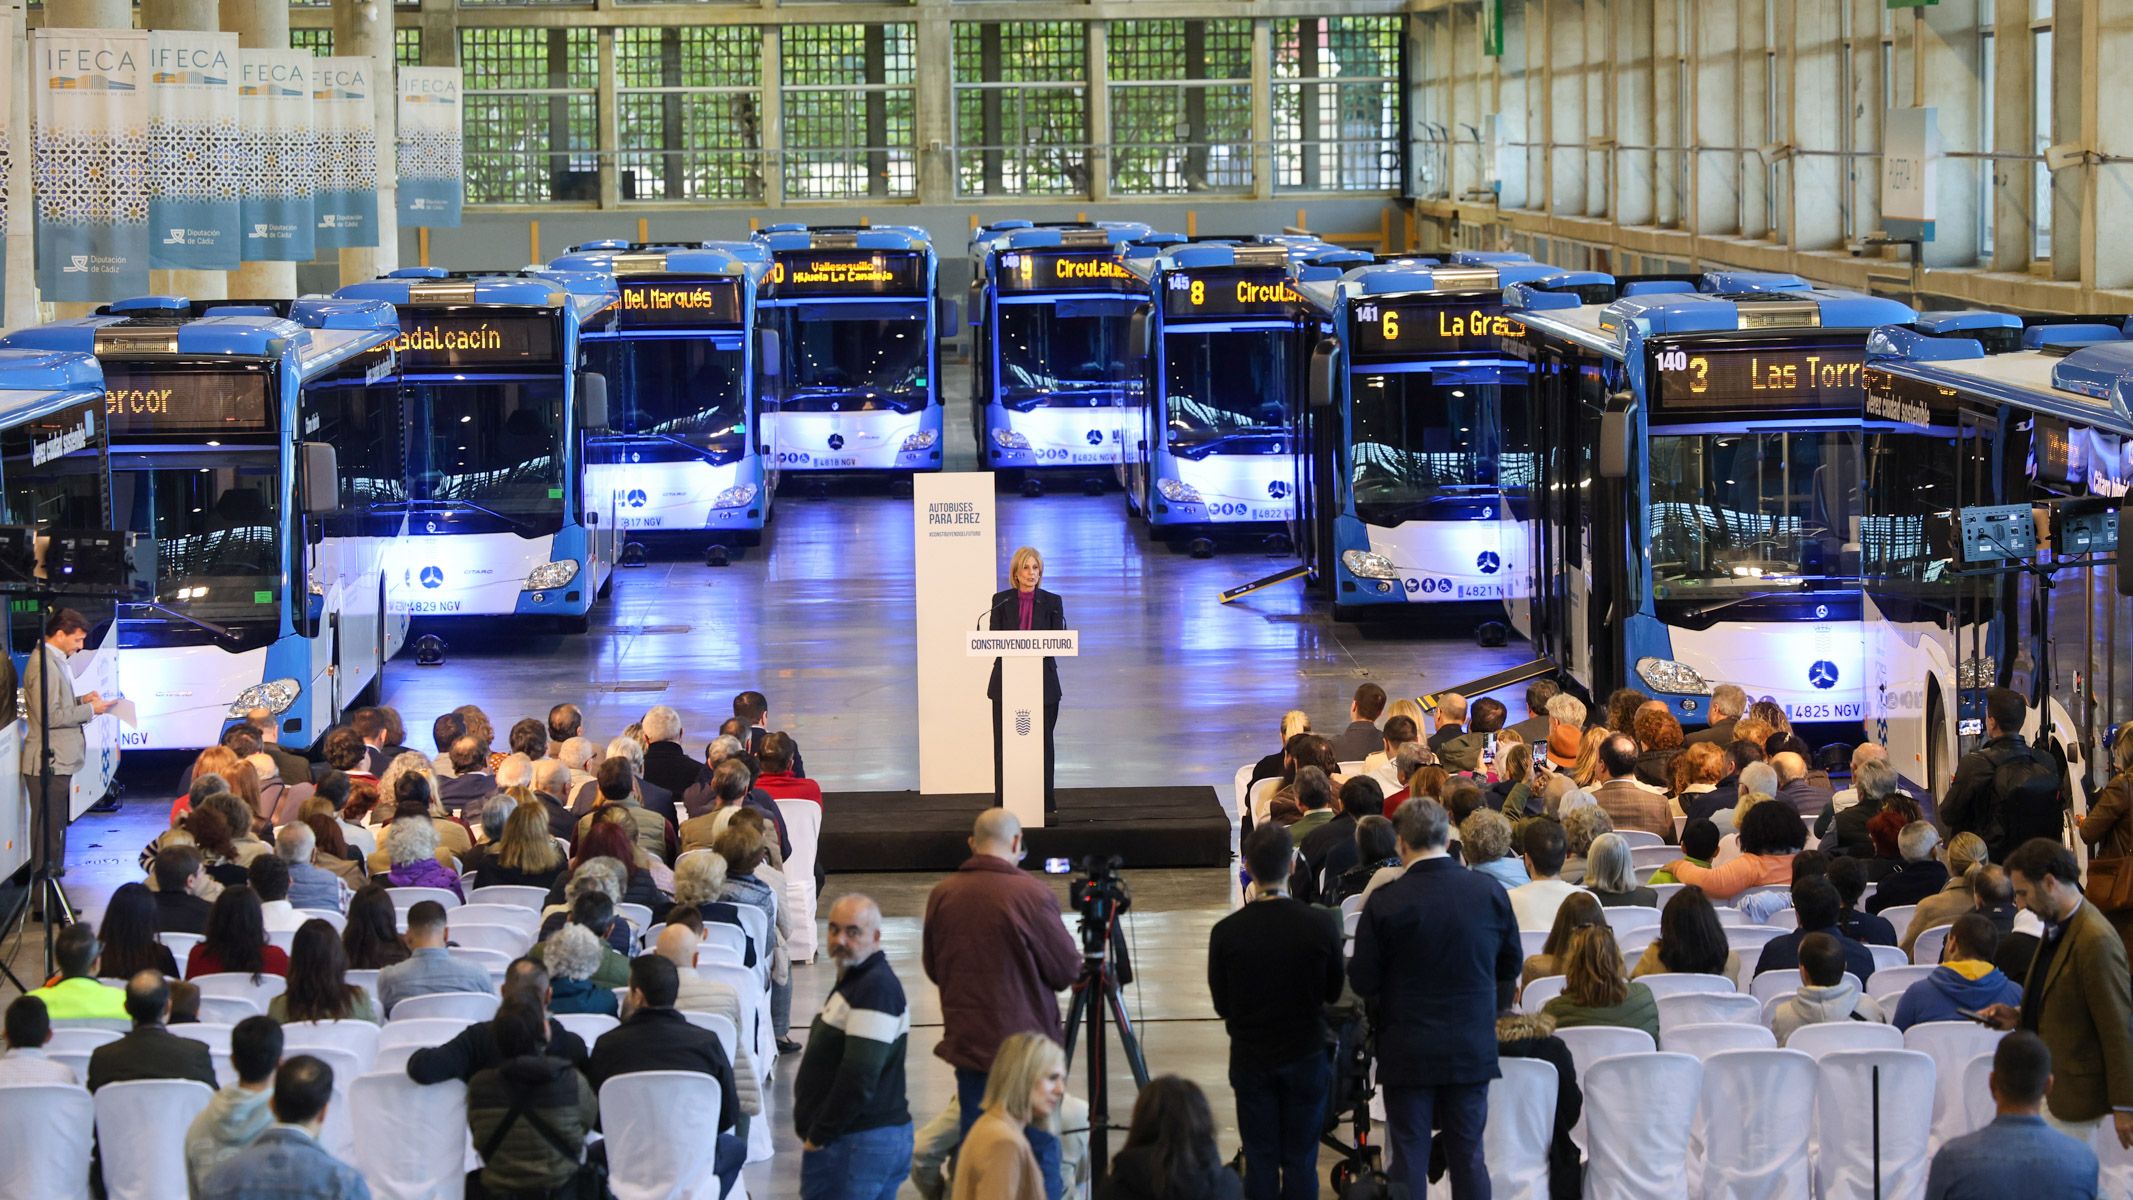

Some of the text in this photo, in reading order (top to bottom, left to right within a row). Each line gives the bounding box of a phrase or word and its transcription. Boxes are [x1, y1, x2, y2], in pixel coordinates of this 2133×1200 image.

[48, 48, 136, 71] IFECA
[151, 48, 229, 69] IFECA
[243, 64, 304, 82] FECA
[404, 79, 457, 93] IFECA
[187, 228, 221, 238] Diputación
[90, 255, 127, 265] Diputación
[1020, 255, 1114, 280] 9 Circula
[90, 265, 100, 273] de
[773, 262, 785, 284] 0
[831, 271, 846, 283] La
[1168, 275, 1190, 290] 145
[623, 288, 648, 310] Del
[650, 287, 712, 310] Marqués
[1190, 280, 1289, 305] 8 Circul
[1355, 305, 1378, 323] 141
[1382, 310, 1504, 340] 6 La Gra
[400, 323, 501, 350] adalcacín
[1655, 351, 1687, 371] 140
[1689, 356, 1862, 393] 3 Las Torr
[105, 389, 173, 414] ercor
[929, 502, 974, 513] AUTOBUSES
[624, 517, 662, 527] 817 NGV
[929, 512, 981, 525] PARA JEREZ
[1465, 585, 1492, 597] 4821
[439, 600, 461, 612] NGV
[971, 638, 1074, 650] CONSTRUYENDO EL FUTURO.
[1795, 703, 1861, 718] 4825 NGV
[121, 731, 148, 745] NGV
